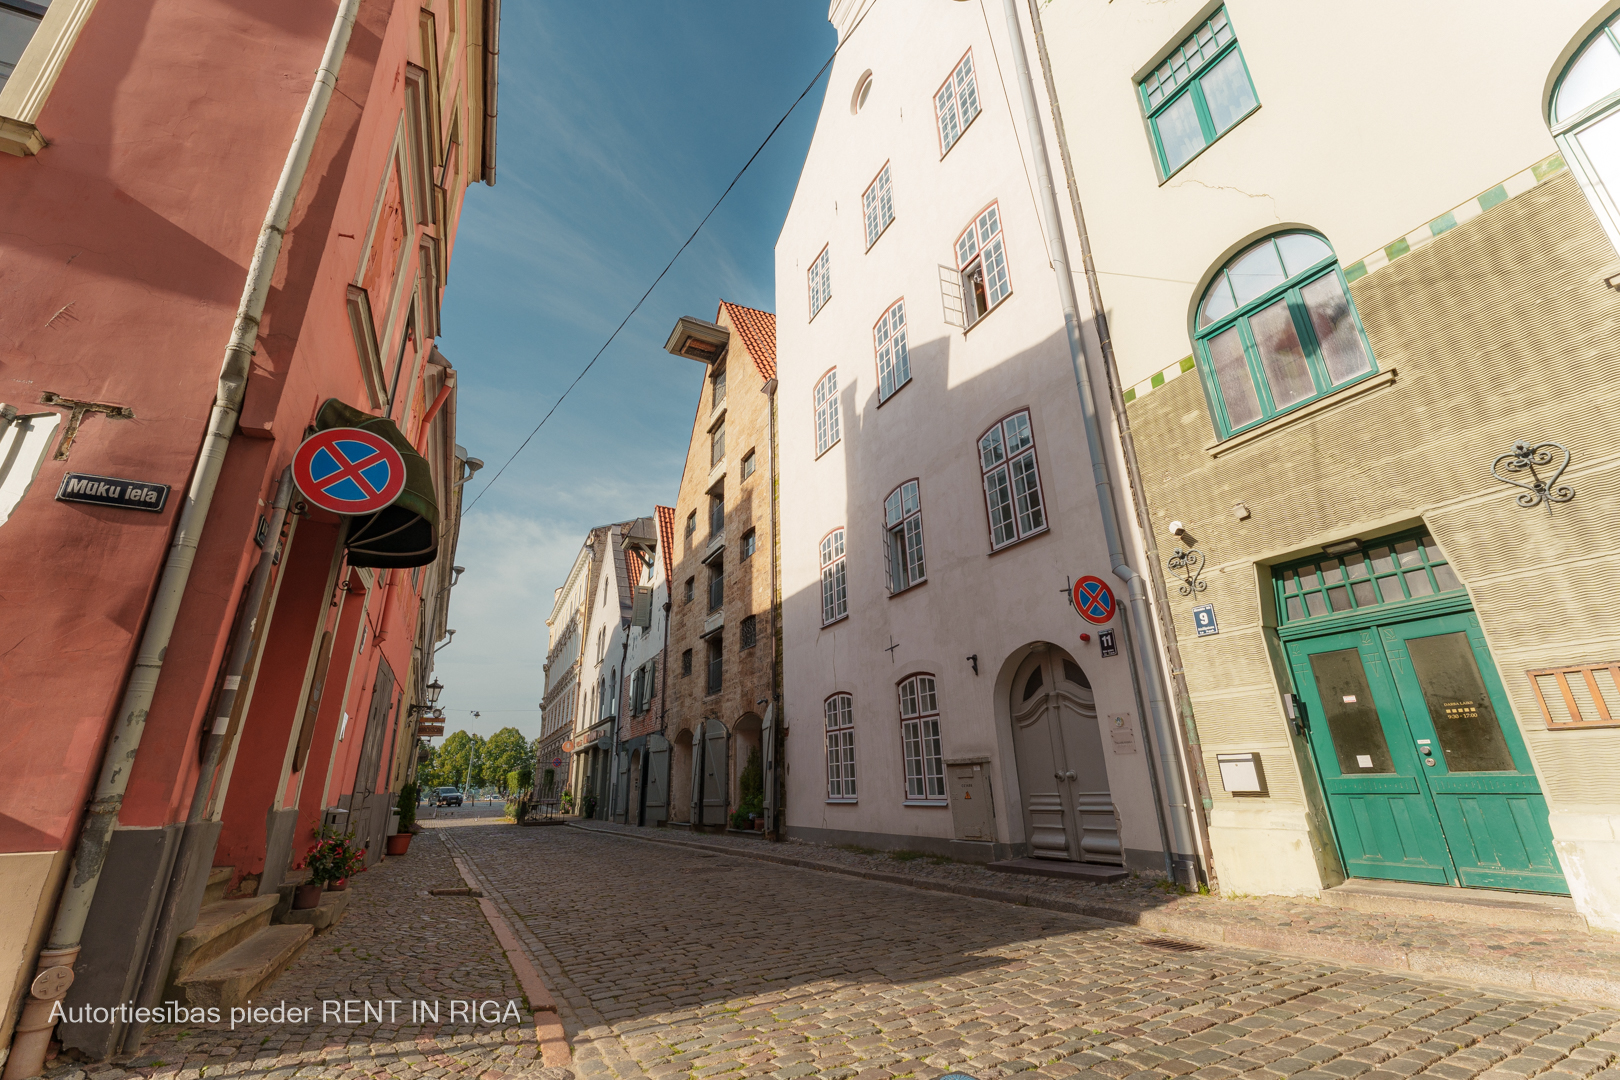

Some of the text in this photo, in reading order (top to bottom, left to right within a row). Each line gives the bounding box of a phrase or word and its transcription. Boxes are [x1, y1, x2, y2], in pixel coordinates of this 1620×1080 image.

[66, 478, 158, 503] Mūku iela
[1199, 612, 1209, 625] 9
[1101, 635, 1112, 647] 11
